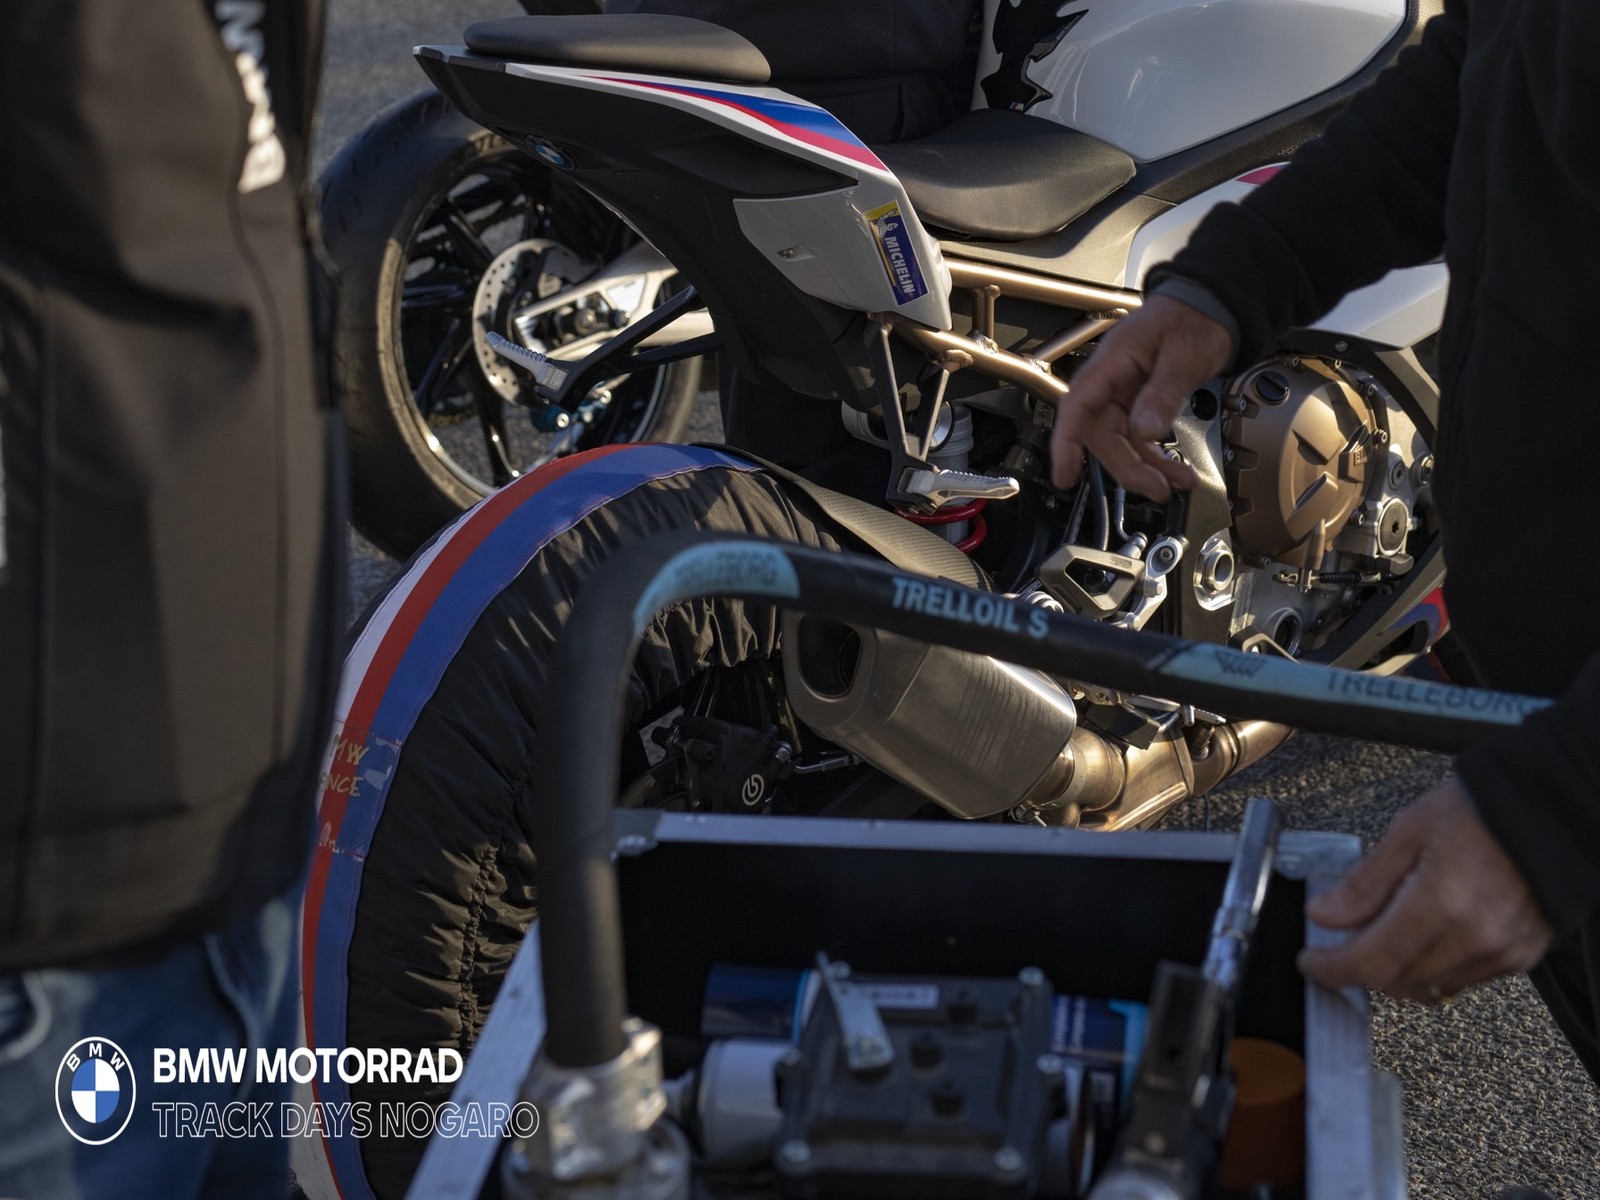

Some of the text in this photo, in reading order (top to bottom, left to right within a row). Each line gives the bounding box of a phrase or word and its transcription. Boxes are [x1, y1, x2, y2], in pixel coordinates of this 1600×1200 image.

[884, 236, 916, 294] MICHELIN
[892, 576, 1050, 639] TRELLOIL S
